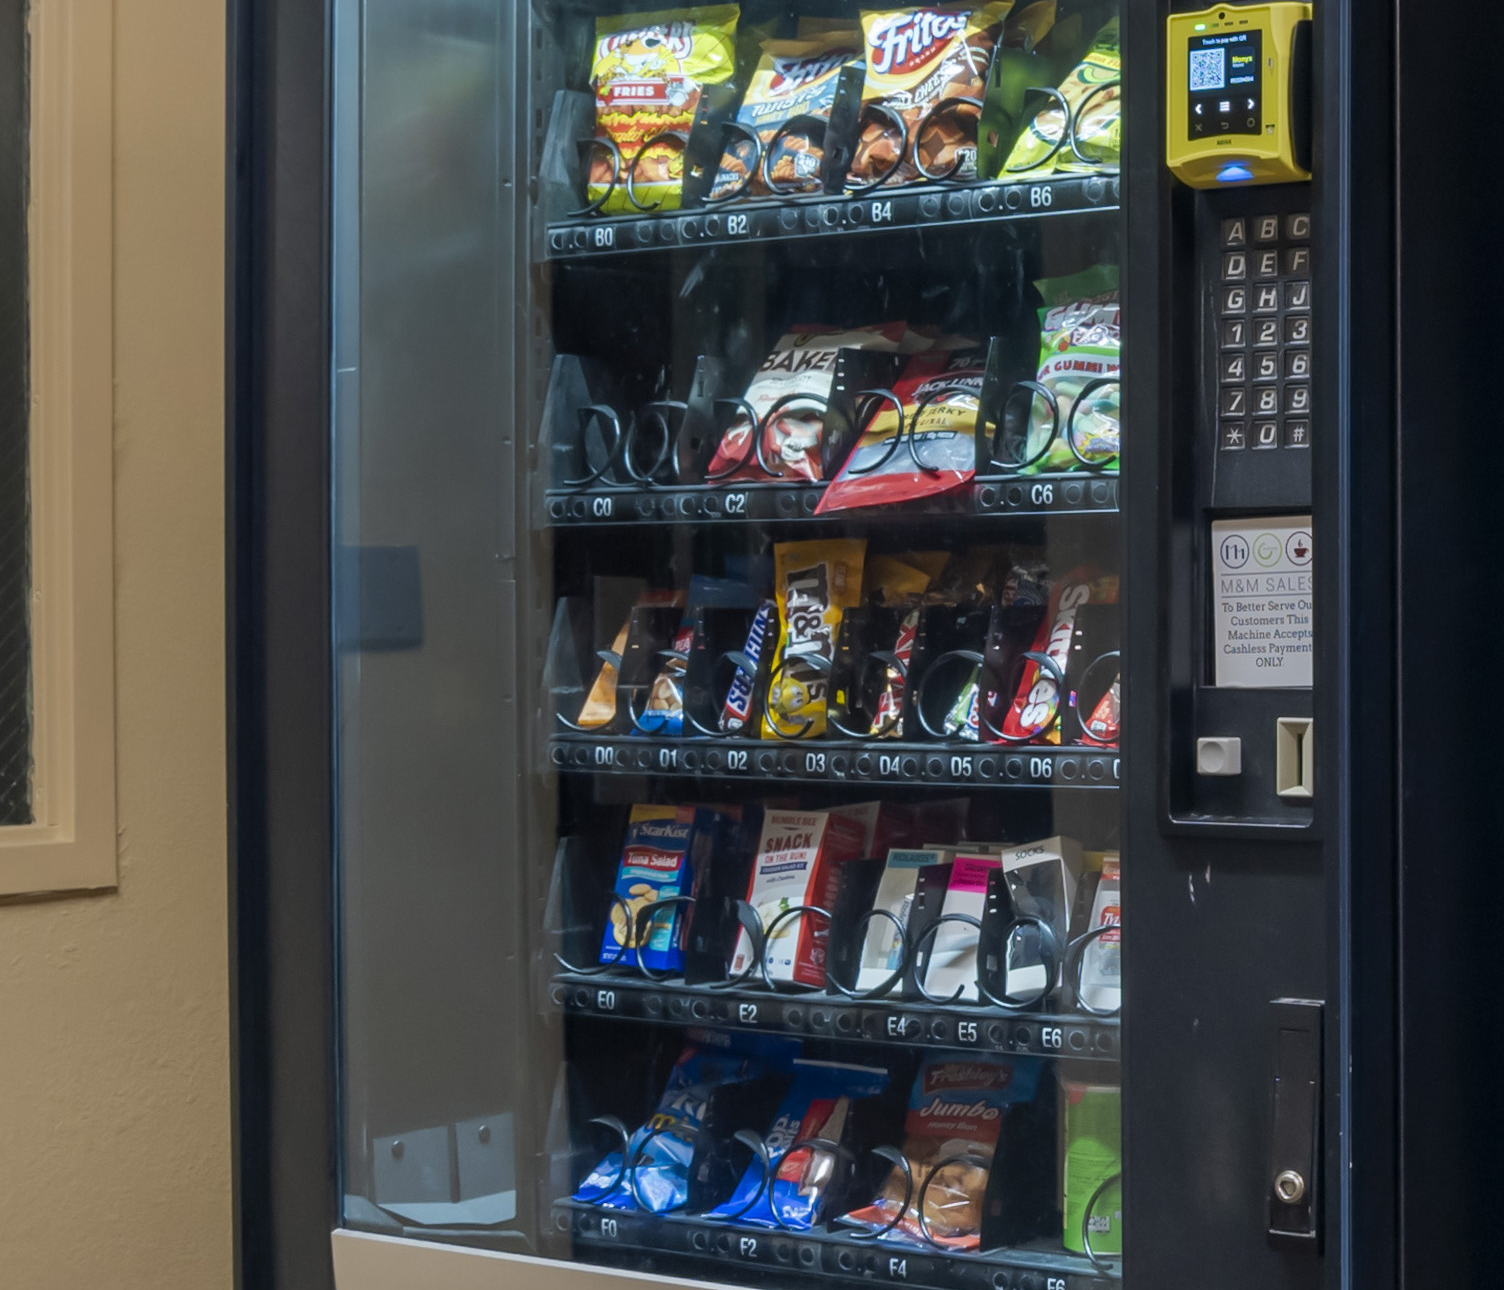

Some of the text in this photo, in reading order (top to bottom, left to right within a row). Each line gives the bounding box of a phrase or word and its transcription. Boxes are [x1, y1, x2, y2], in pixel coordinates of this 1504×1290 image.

[612, 84, 656, 99] FRIES
[1030, 186, 1053, 207] B6
[725, 494, 745, 514] C2
[1221, 578, 1259, 593] M&M
[1221, 600, 1296, 612] To Better Serve
[1230, 614, 1309, 626] Customers This
[1228, 629, 1313, 641] Machine Accepts
[1223, 643, 1313, 655] Cashless Payment
[805, 754, 826, 774] D3
[639, 822, 690, 839] StarKist
[765, 833, 813, 853] SNACK
[627, 851, 678, 868] Tuna Salad
[1014, 844, 1045, 861] SOCKS
[1042, 1028, 1062, 1049] E6
[920, 1097, 999, 1120] Jumbo
[889, 1258, 908, 1278] F4
